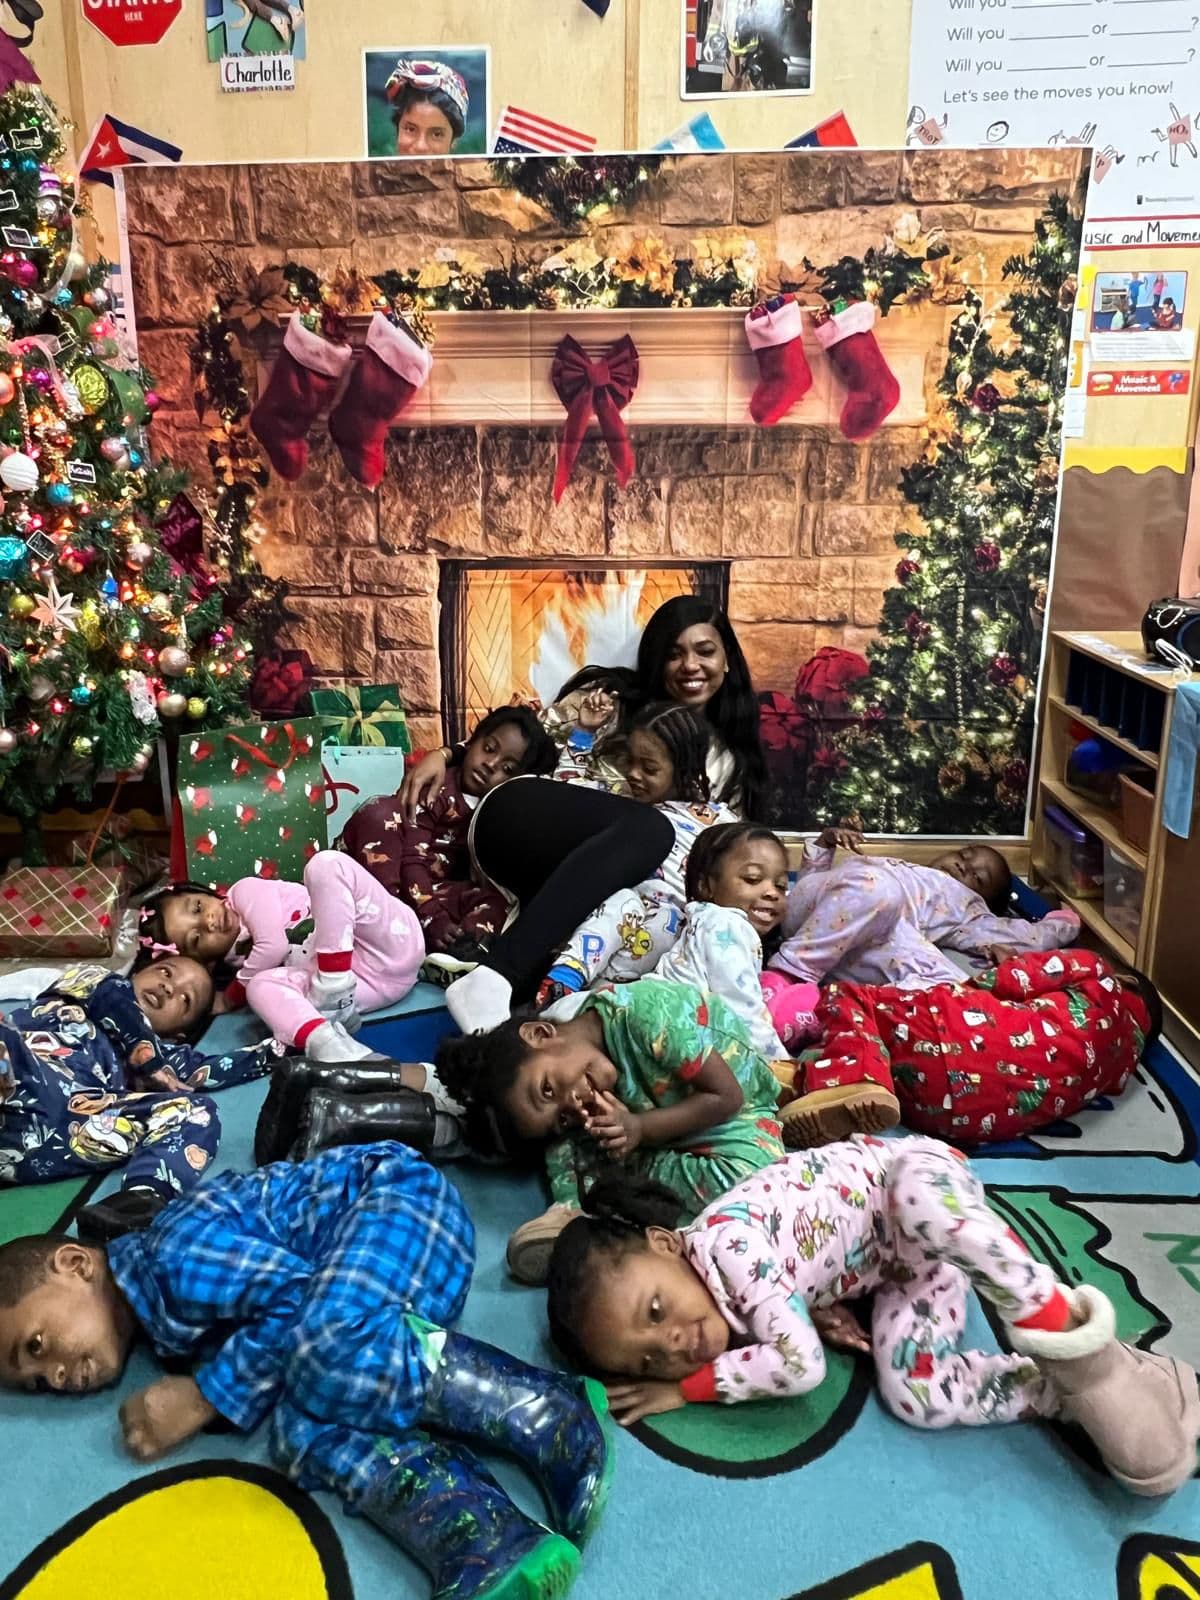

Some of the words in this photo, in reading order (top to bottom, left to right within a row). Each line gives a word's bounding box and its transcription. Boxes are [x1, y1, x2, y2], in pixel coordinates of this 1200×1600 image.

[947, 28, 973, 41] Will
[978, 29, 1005, 43] you
[1092, 24, 1108, 35] or
[225, 60, 292, 83] Charlotte
[945, 59, 971, 72] Will
[976, 60, 1003, 75] you
[1089, 55, 1106, 66] or
[943, 89, 978, 103] Let's
[983, 90, 1009, 101] see
[1014, 87, 1039, 100] the
[1043, 86, 1092, 99] moves
[1097, 85, 1125, 100] you
[1129, 81, 1173, 96] know!
[1084, 232, 1113, 245] usic
[1121, 230, 1143, 244] and
[1114, 383, 1161, 393] Movement
